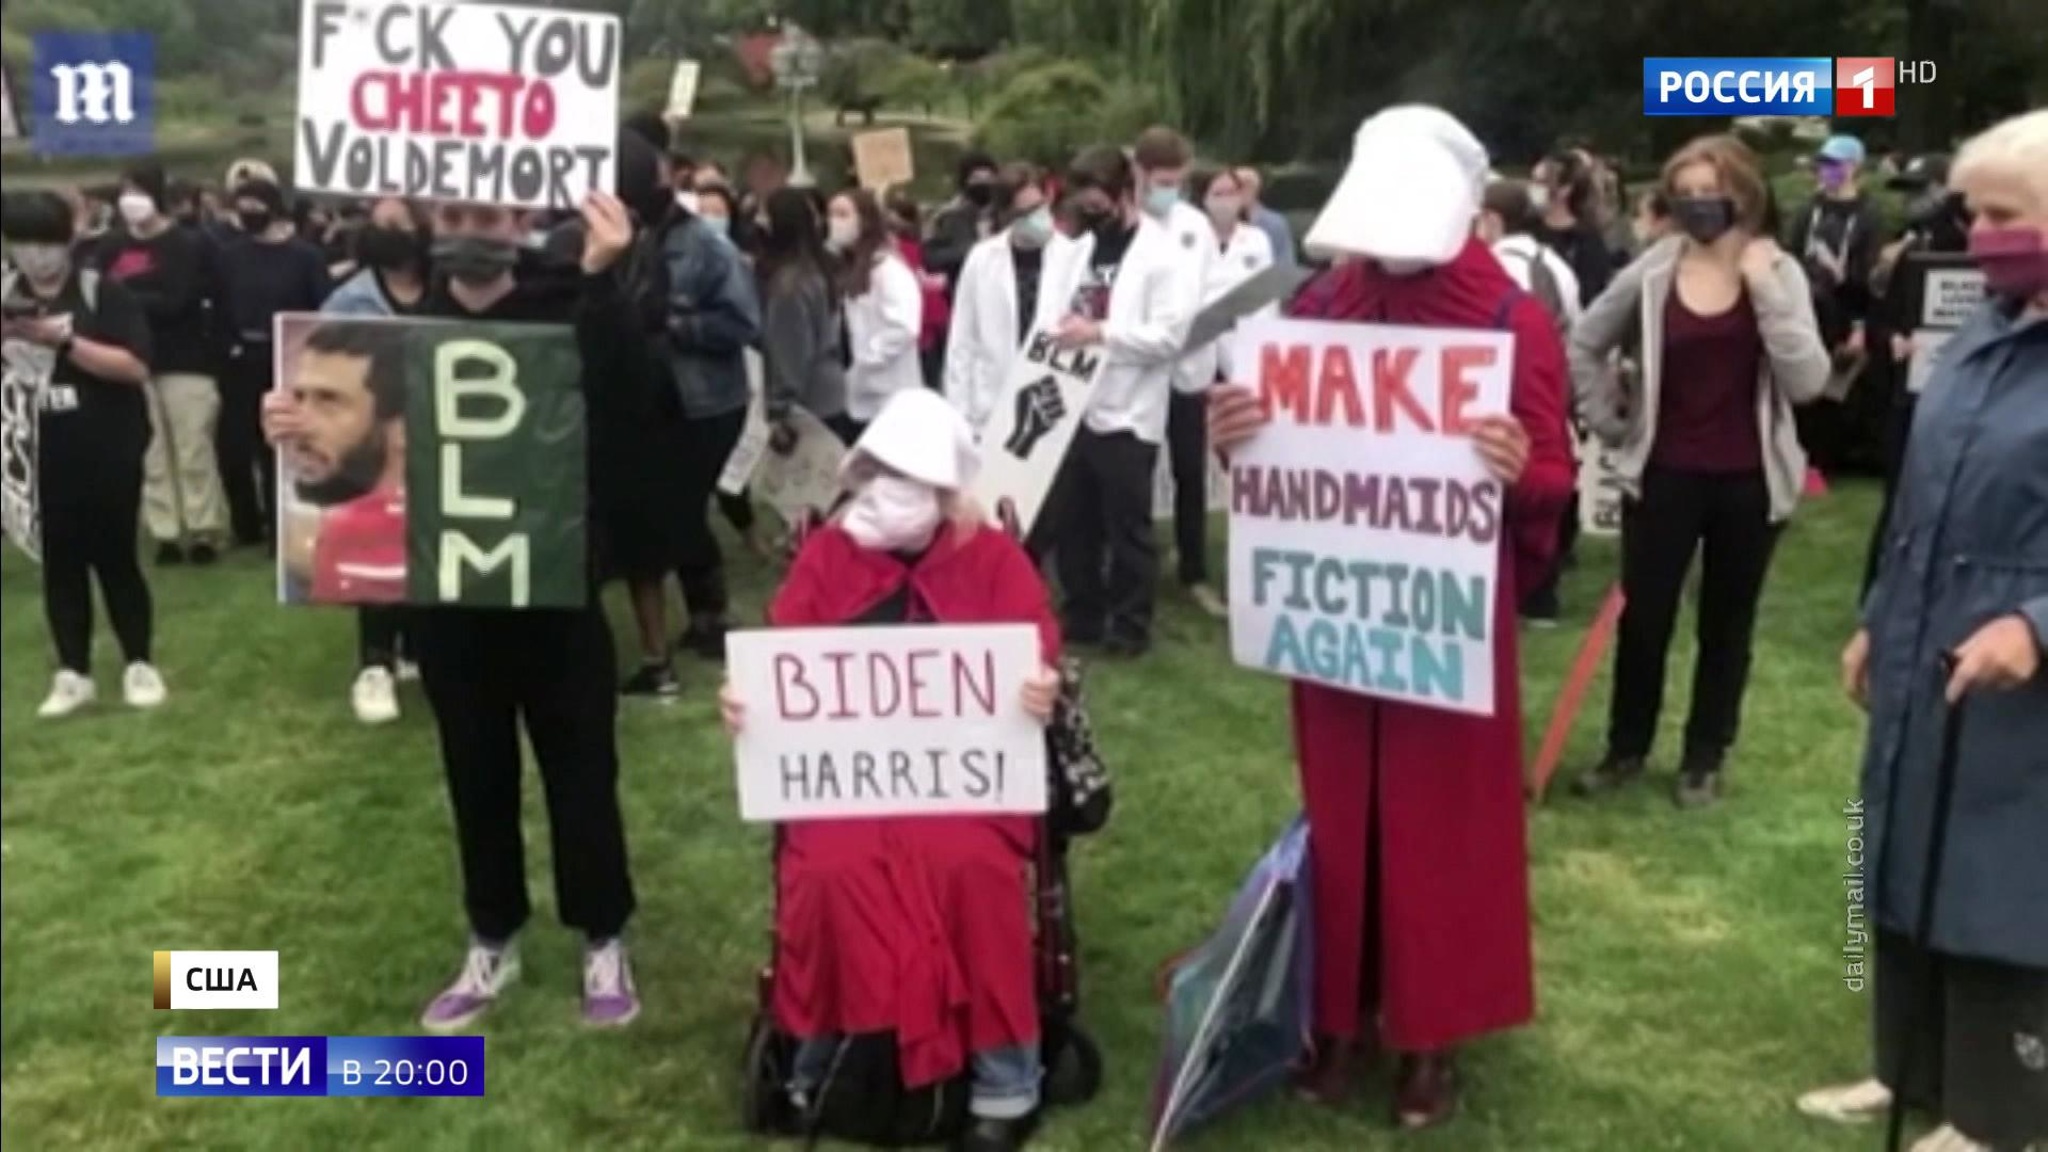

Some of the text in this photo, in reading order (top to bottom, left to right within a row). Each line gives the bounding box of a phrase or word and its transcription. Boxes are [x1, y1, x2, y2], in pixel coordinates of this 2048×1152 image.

[495, 11, 617, 89] YOU
[350, 69, 557, 140] CHEETO
[302, 117, 610, 209] VOLDEMORT
[1027, 330, 1099, 384] BLM
[1260, 343, 1497, 437] MAKE
[434, 338, 530, 608] BLM
[1231, 465, 1496, 544] HANDMAIDS
[1252, 546, 1487, 642] FICTION
[773, 649, 998, 721] BIDEN
[1263, 613, 1464, 701] AGAIN
[779, 749, 1006, 802] HARRIS!
